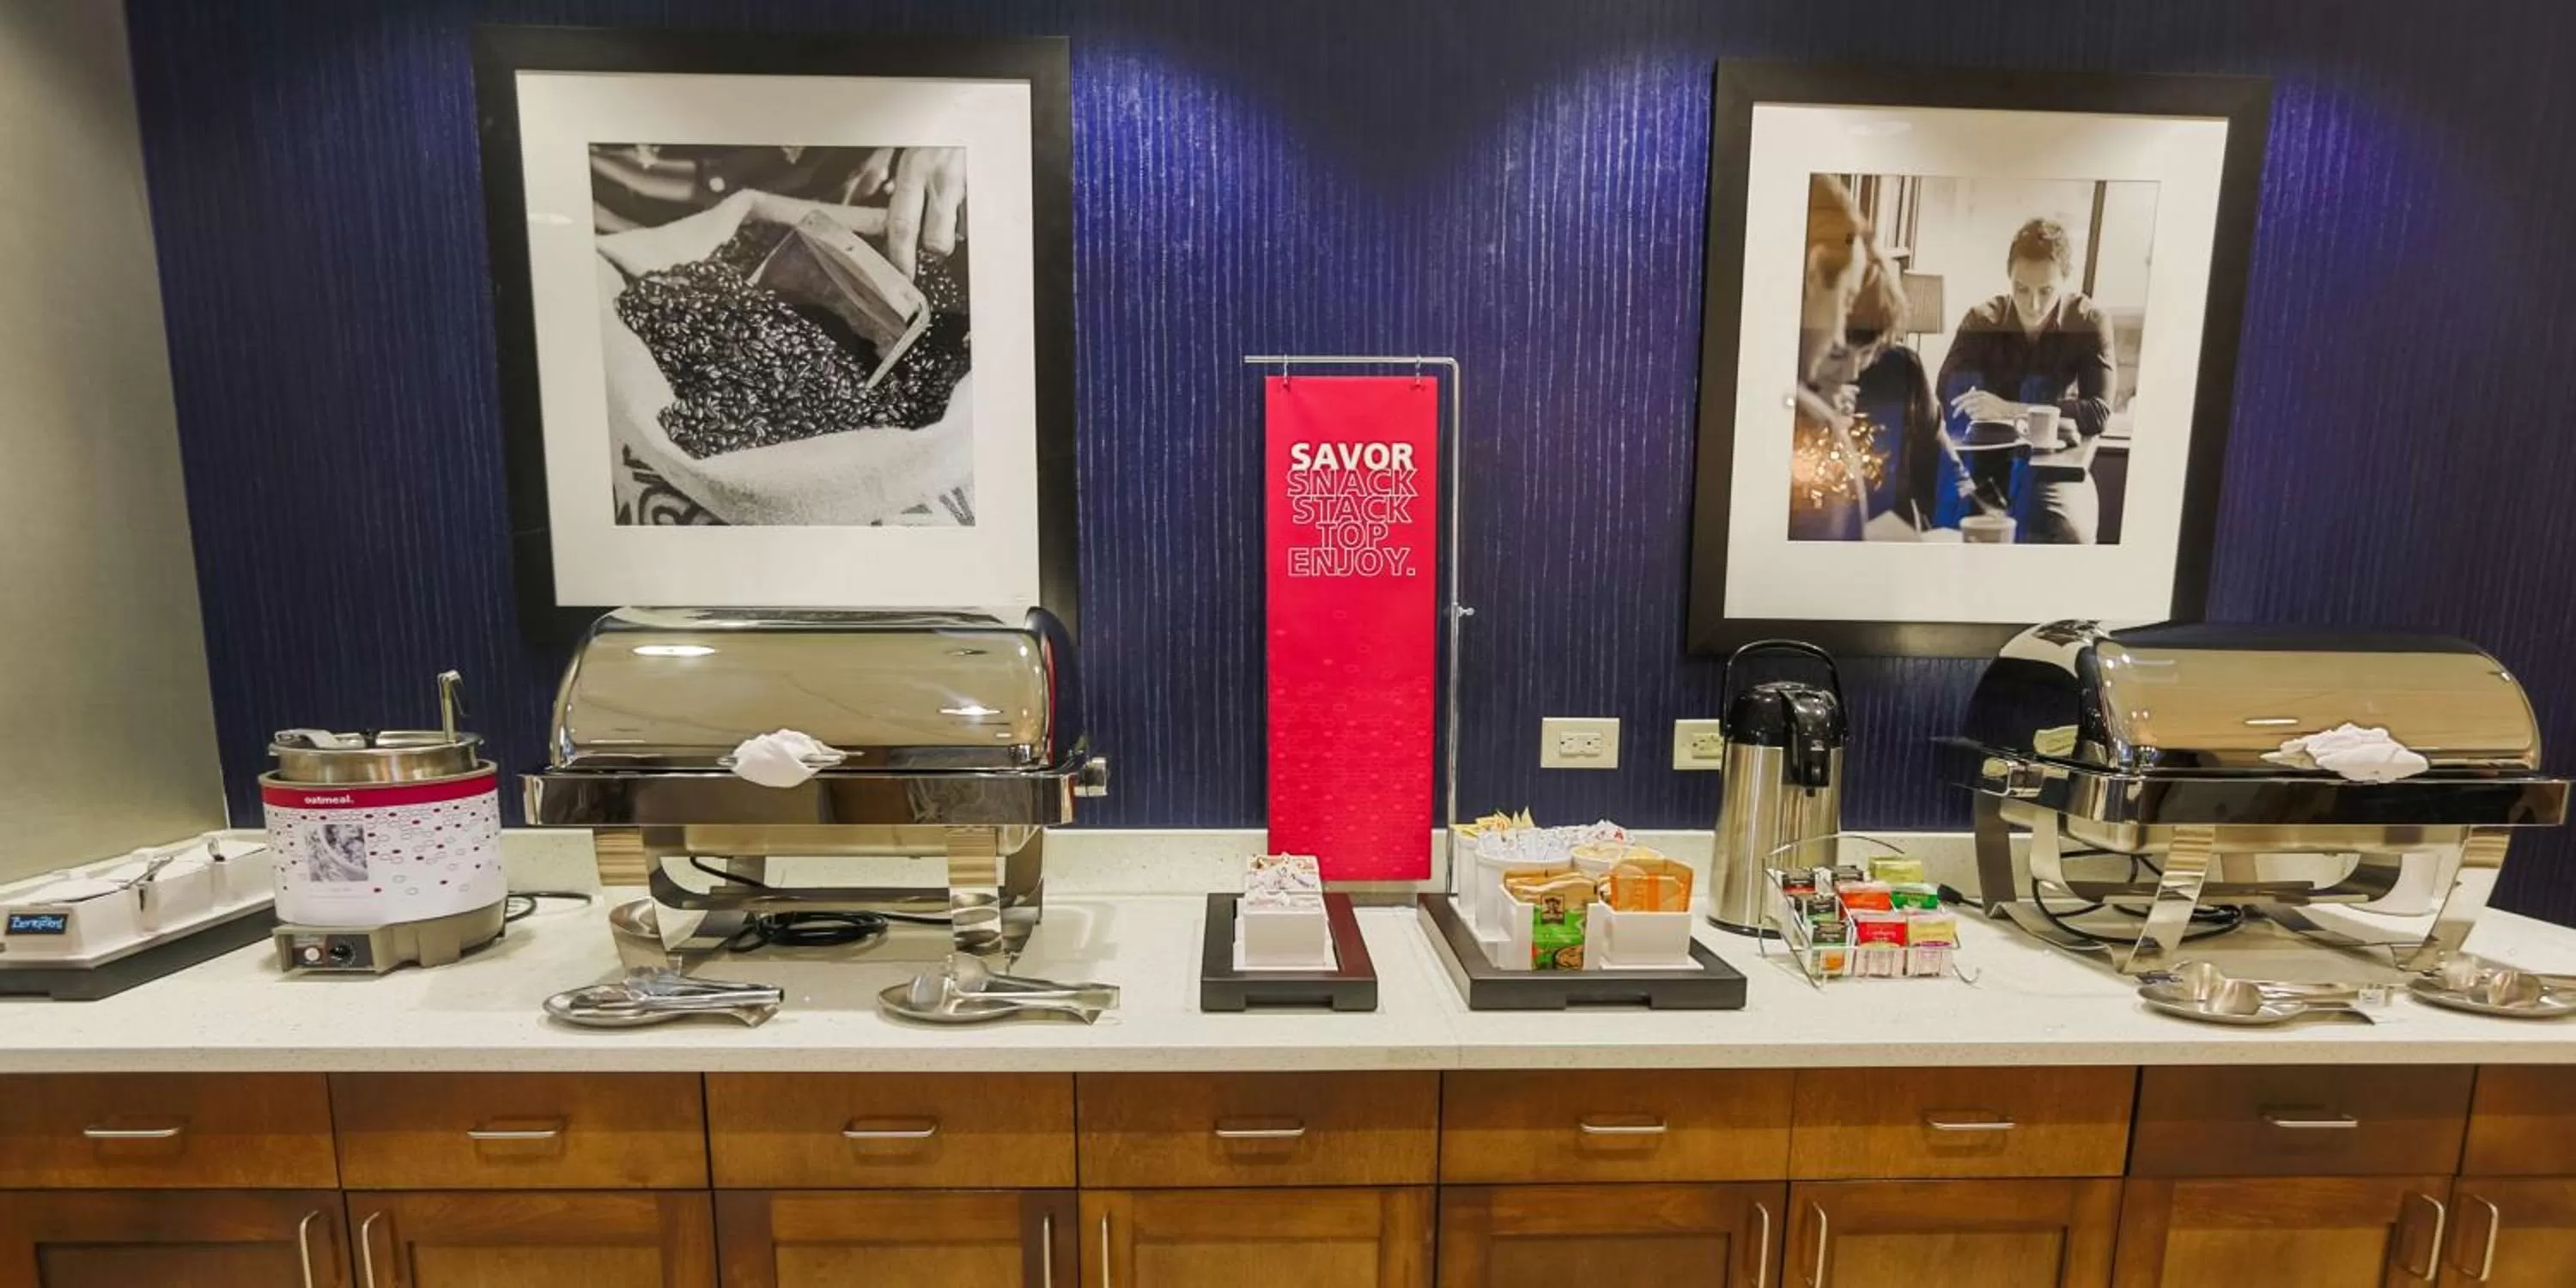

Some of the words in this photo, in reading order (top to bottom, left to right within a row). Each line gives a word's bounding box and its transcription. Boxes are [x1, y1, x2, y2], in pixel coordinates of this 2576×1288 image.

[1291, 442, 1414, 471] SAVOR
[1287, 468, 1419, 496] SNACK
[1292, 495, 1412, 524] STACK
[1315, 521, 1388, 550] TOP
[1288, 547, 1416, 576] ENJOY.
